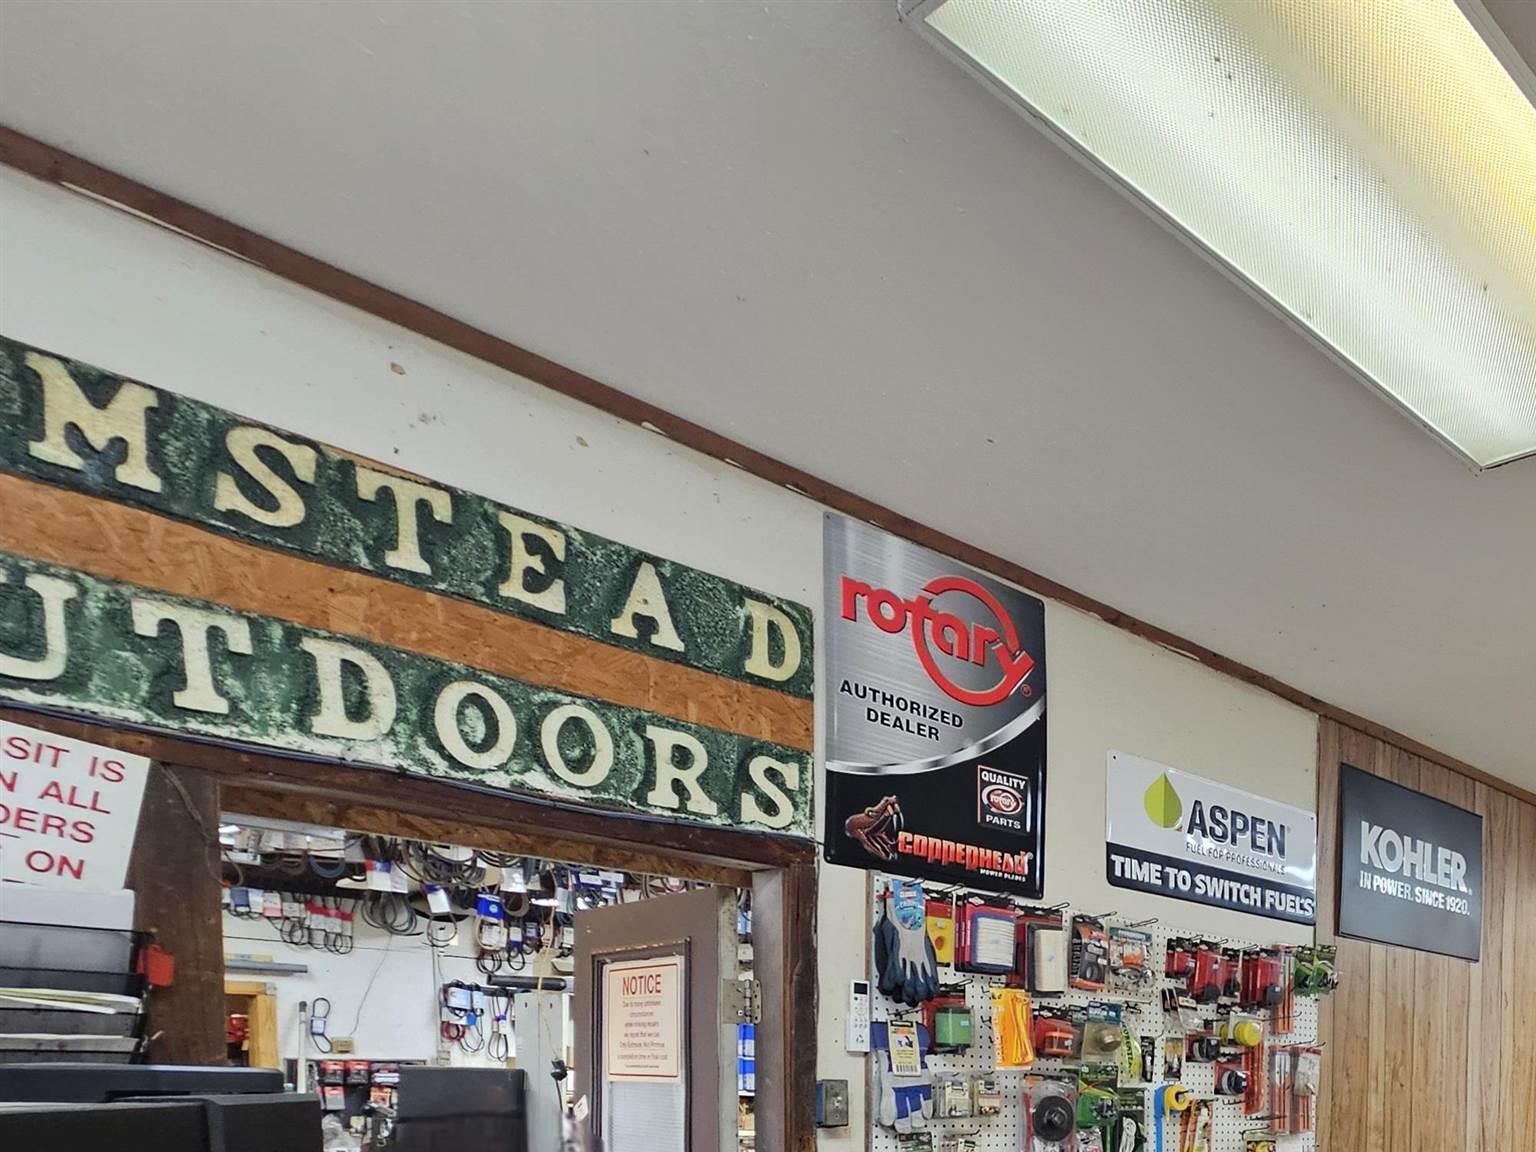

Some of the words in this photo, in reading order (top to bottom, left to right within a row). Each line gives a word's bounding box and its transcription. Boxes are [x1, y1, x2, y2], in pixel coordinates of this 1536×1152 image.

[839, 575, 1036, 708] rotary
[840, 679, 964, 729] AUTHORIZED
[866, 707, 940, 742] DEALER
[88, 756, 127, 783] IS
[981, 770, 1026, 790] QUALITY
[38, 780, 112, 815] ALL
[985, 814, 1021, 830] PARTS
[1187, 799, 1287, 860] ASPEN
[24, 849, 85, 881] ON
[897, 830, 1029, 876] COPPERHEAD
[1360, 820, 1468, 894] KOHLER
[1110, 854, 1163, 887] TIME
[1164, 866, 1192, 891] TO
[1194, 874, 1262, 909] SWITCH
[1265, 890, 1315, 918] FUELS
[1359, 870, 1373, 891] IN
[1373, 875, 1414, 901] POWER.
[1415, 885, 1445, 911] SINCE
[1445, 894, 1471, 917] 1920.
[622, 974, 662, 997] NOTICE
